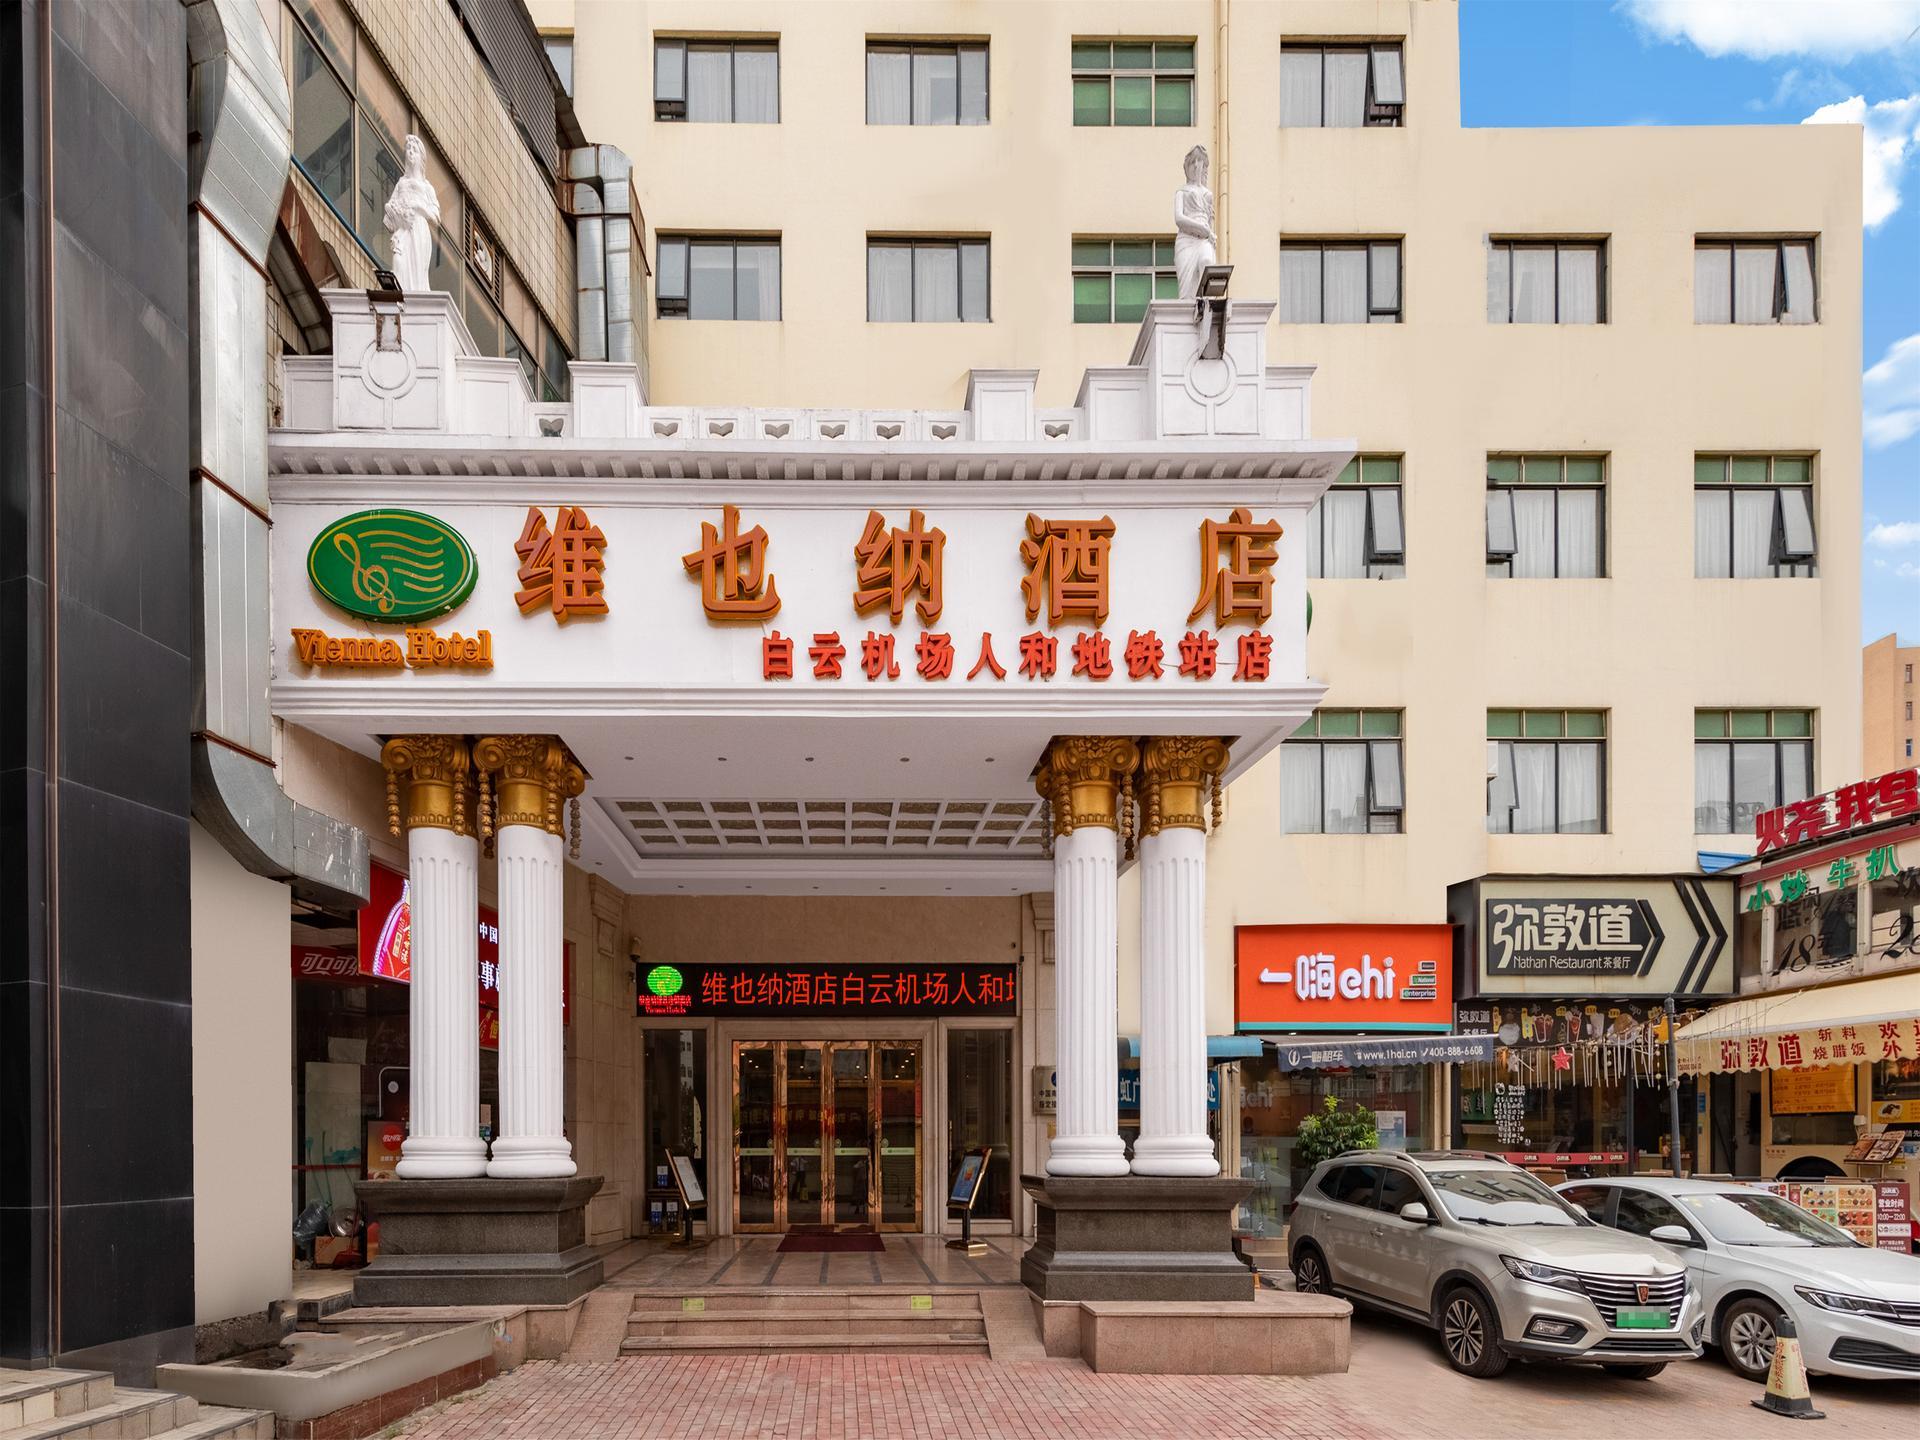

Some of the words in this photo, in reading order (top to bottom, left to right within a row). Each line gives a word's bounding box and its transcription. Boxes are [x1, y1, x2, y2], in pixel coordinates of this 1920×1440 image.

[514, 505, 1284, 625] 维也纳酒店
[291, 628, 402, 668] Vienna
[405, 628, 493, 668] Hotel
[762, 630, 1274, 681] 白云机场人和地铁站店
[1493, 903, 1643, 968] 弥敦道
[1514, 955, 1548, 969] Nathan
[1550, 955, 1602, 969] Restaurant
[1603, 956, 1631, 969] 茶餐厅
[1429, 1044, 1485, 1057] 400-888-6608
[1720, 1033, 1804, 1070] 弥敦道
[1818, 1026, 1857, 1042] 斩料
[1812, 1042, 1867, 1060] 烧腊饭
